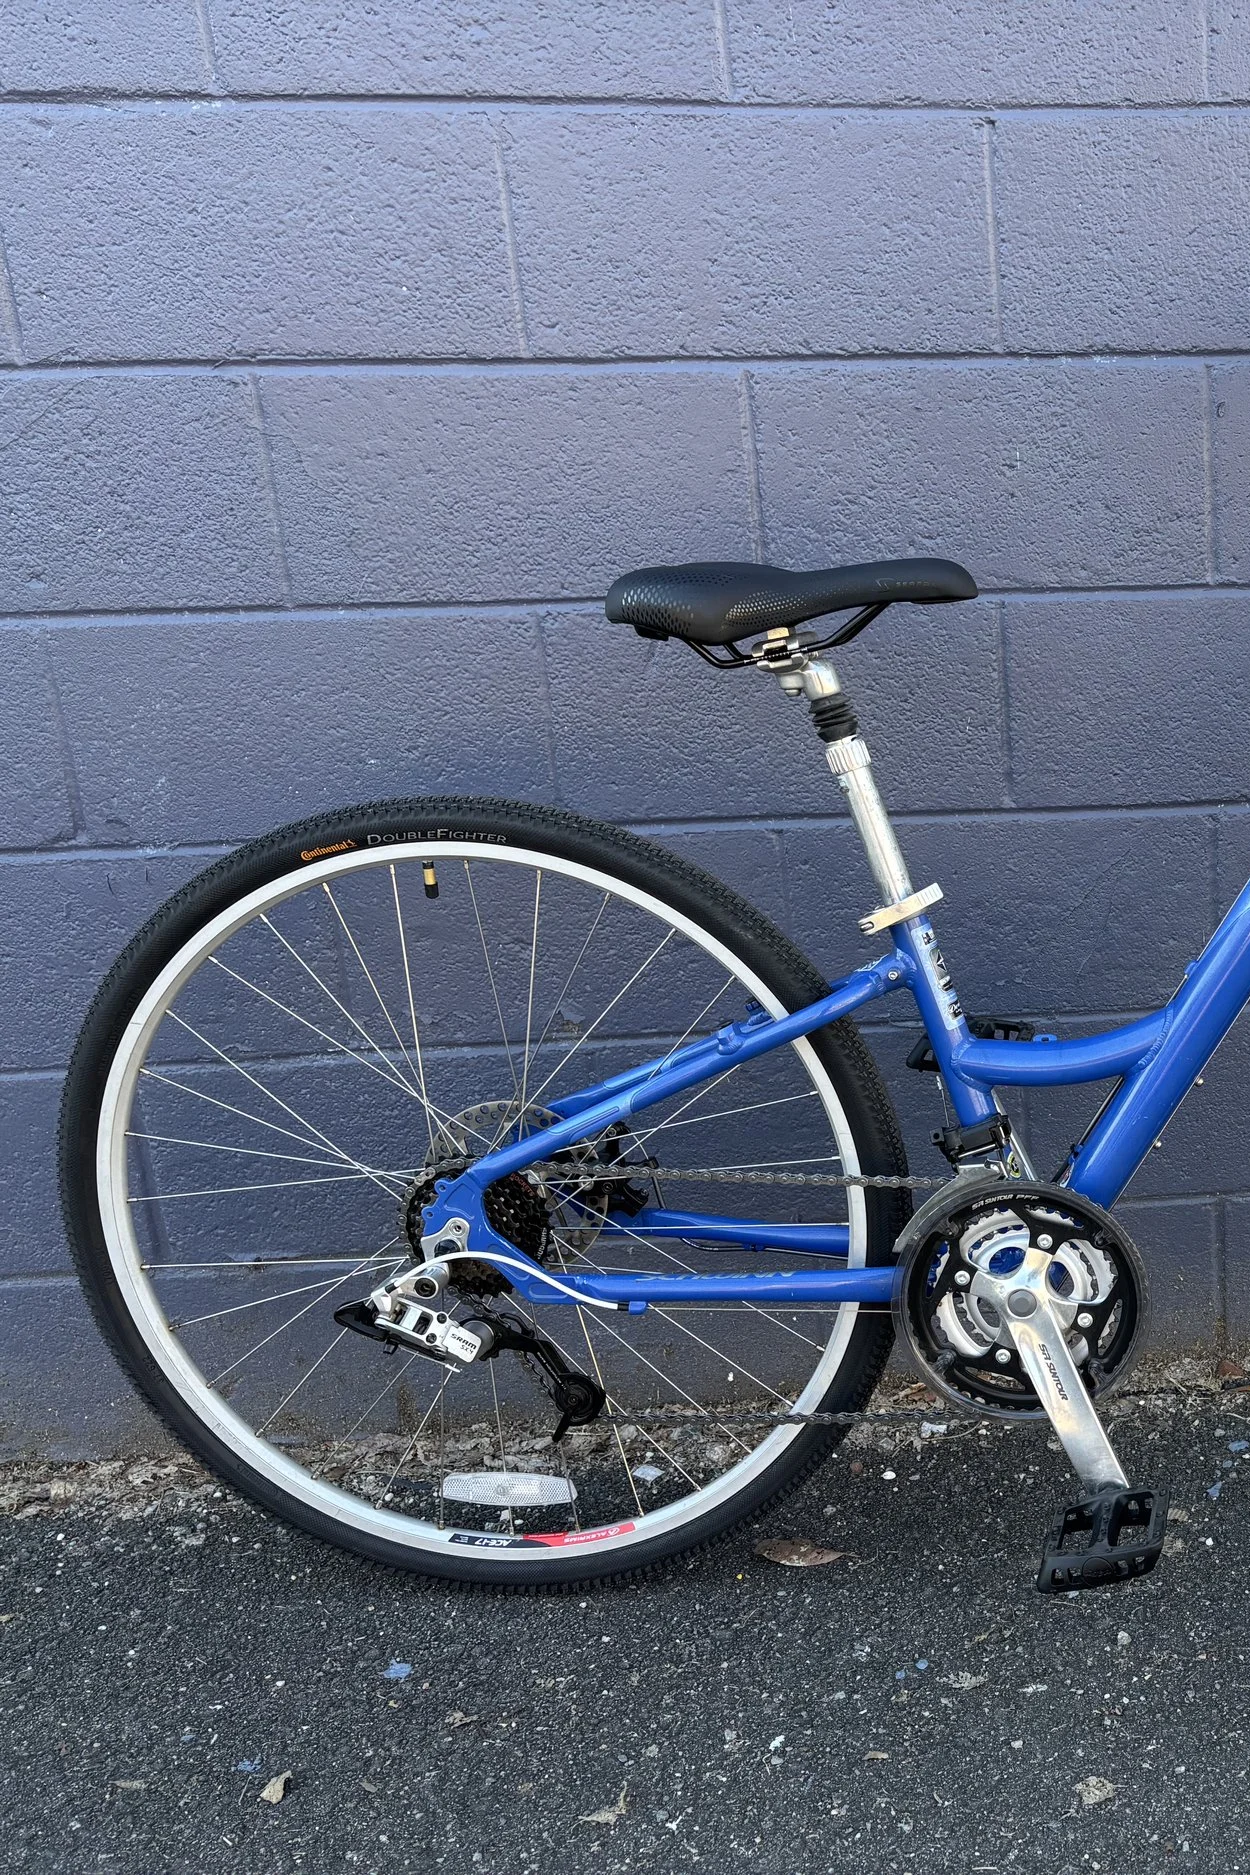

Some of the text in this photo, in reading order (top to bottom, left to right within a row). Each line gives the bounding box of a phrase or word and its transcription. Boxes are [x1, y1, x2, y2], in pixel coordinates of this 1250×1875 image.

[300, 840, 350, 861] Continental
[450, 1332, 478, 1350] SRAM
[1045, 1361, 1069, 1401] SUNTOUR
